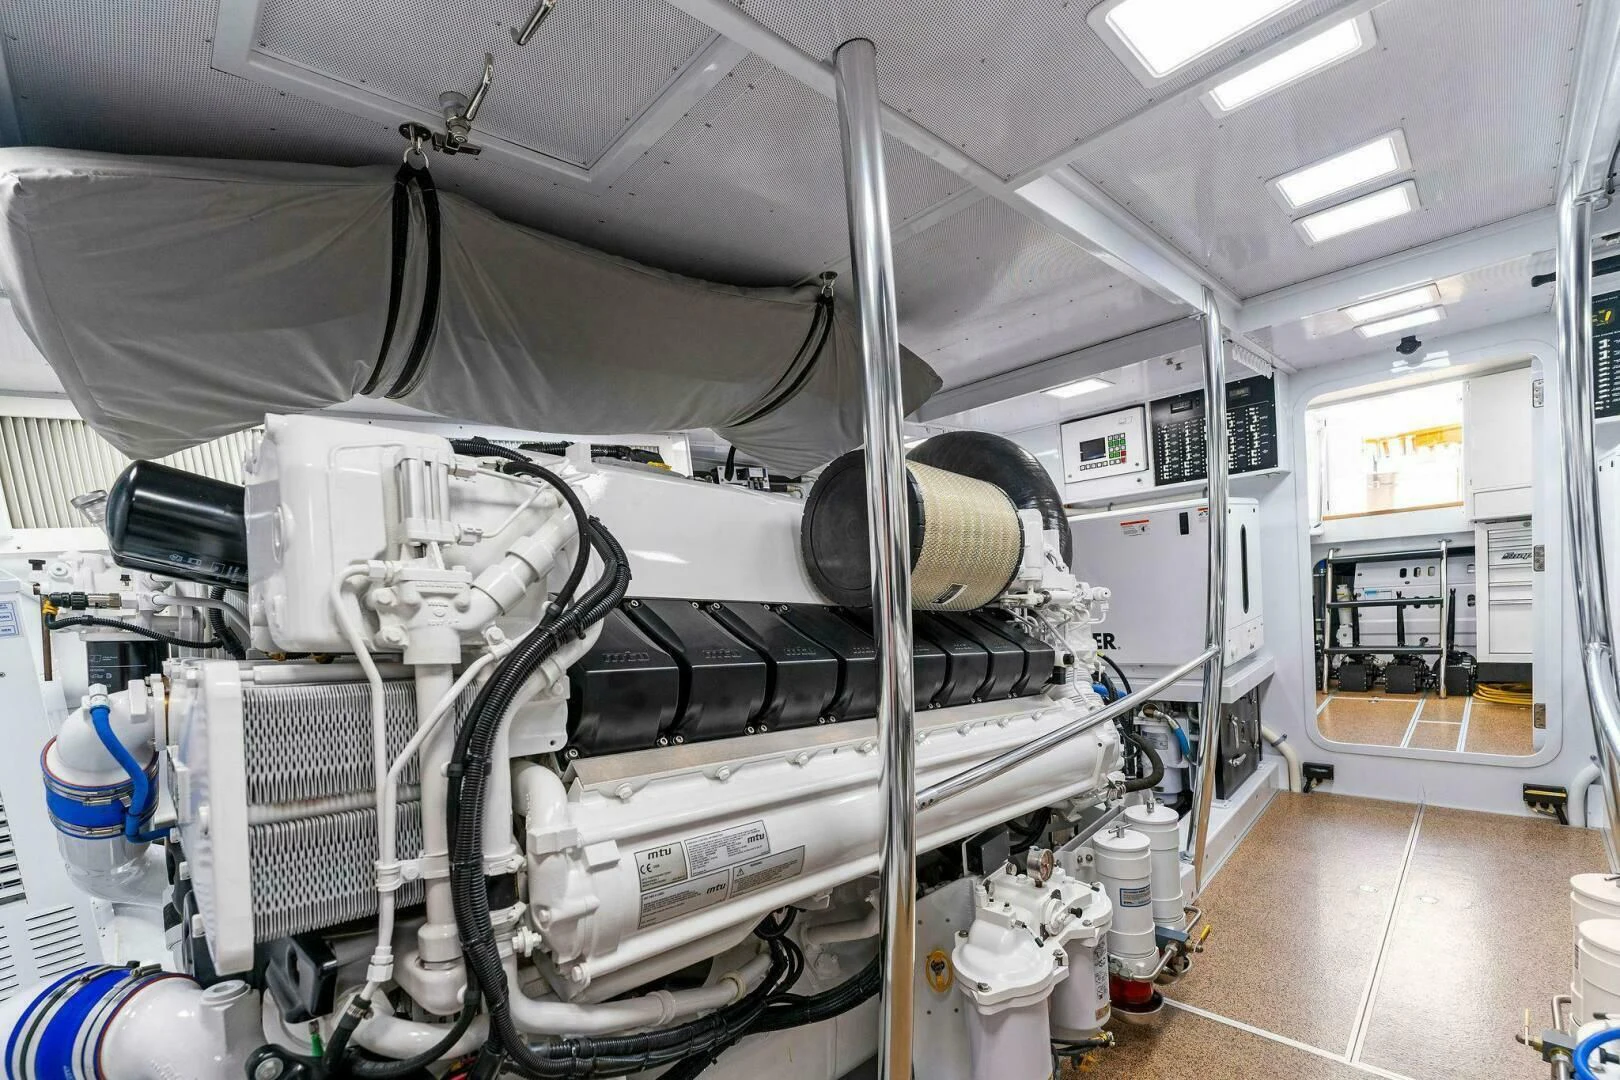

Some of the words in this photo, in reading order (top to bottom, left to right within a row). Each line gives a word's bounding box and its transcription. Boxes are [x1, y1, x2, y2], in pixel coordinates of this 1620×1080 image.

[747, 832, 765, 844] mtu
[648, 848, 671, 860] mtu
[706, 883, 726, 895] mtu
